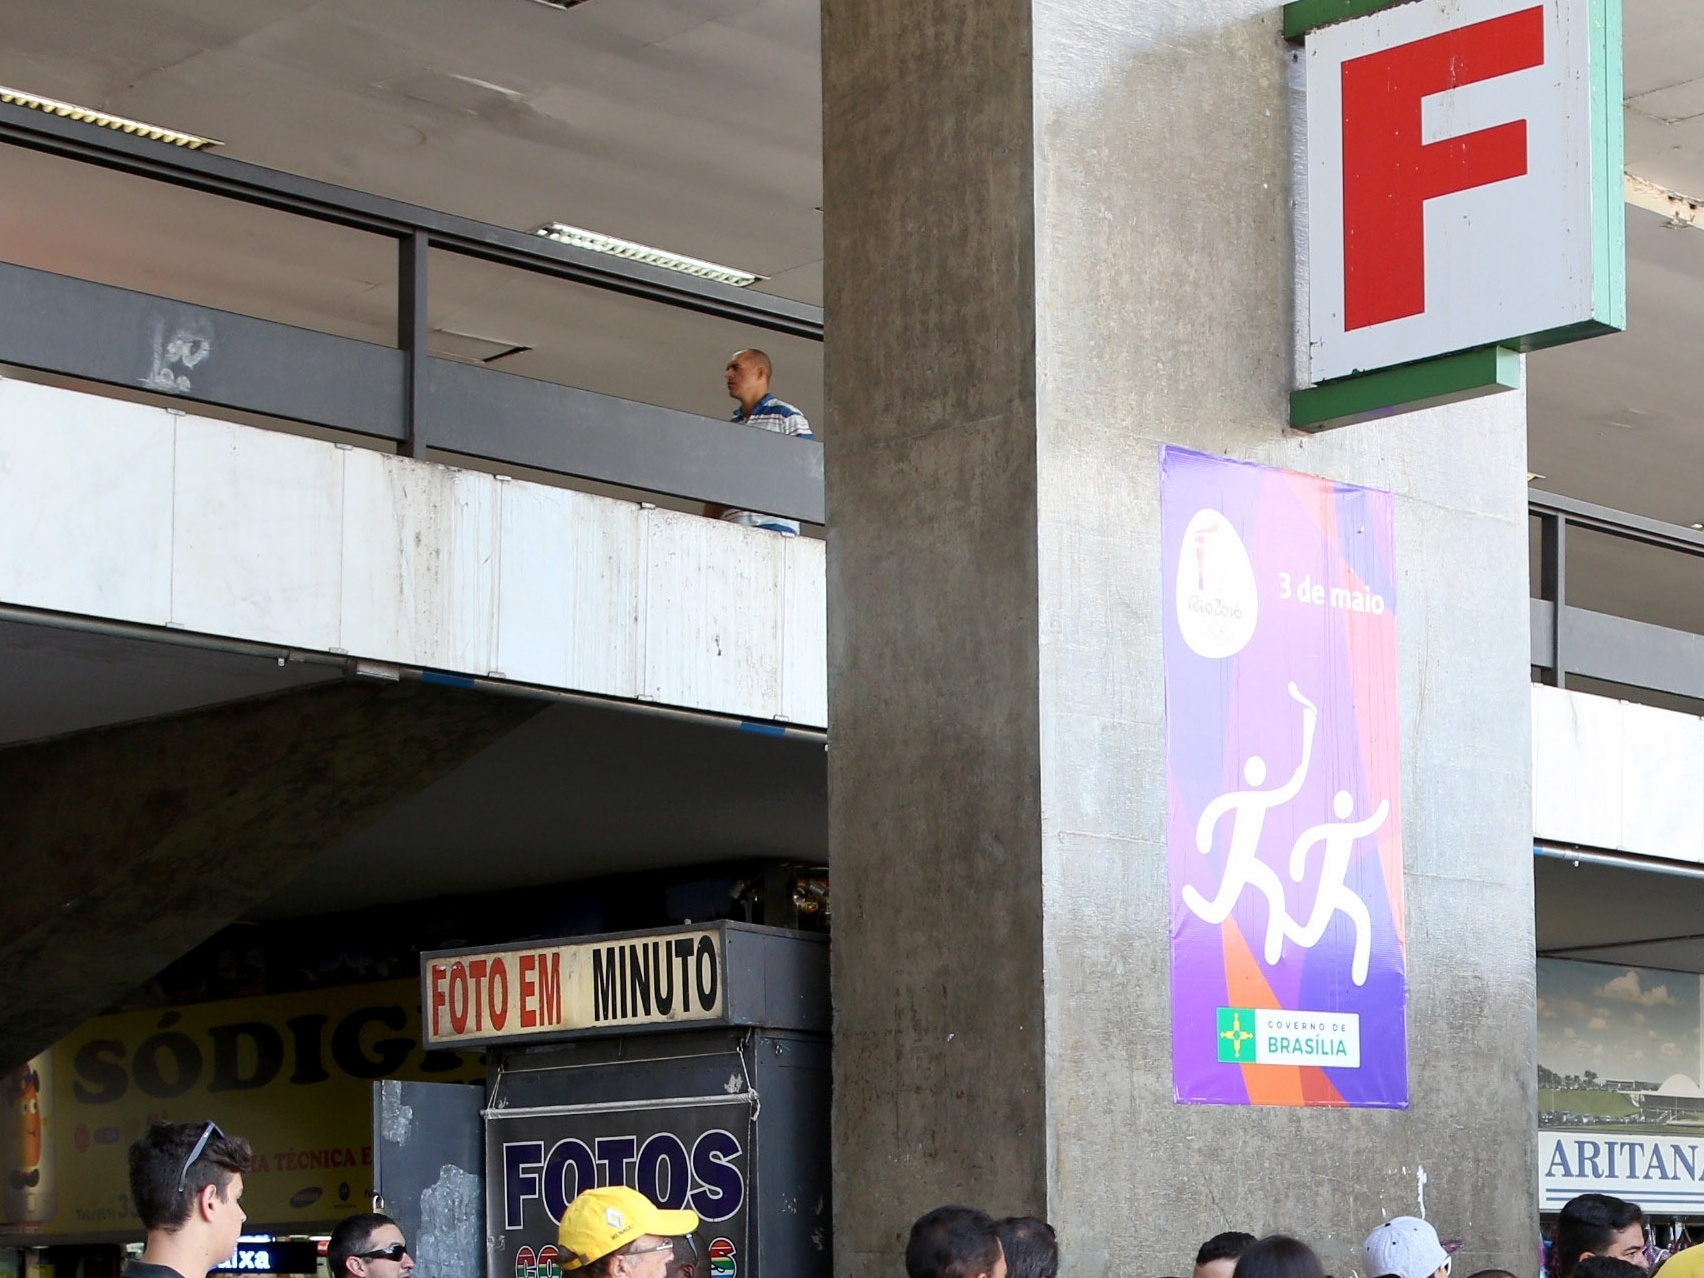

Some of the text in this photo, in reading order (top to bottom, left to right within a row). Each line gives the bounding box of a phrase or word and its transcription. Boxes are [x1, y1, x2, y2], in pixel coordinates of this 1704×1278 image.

[1341, 5, 1544, 332] F
[1278, 571, 1385, 615] 3 de maio
[432, 934, 718, 1037] FOTO EM MINUTO
[1267, 1020, 1346, 1032] GOVERNO DE
[1268, 1034, 1347, 1056] BRASÍLIA
[503, 1128, 745, 1230] FOTOS
